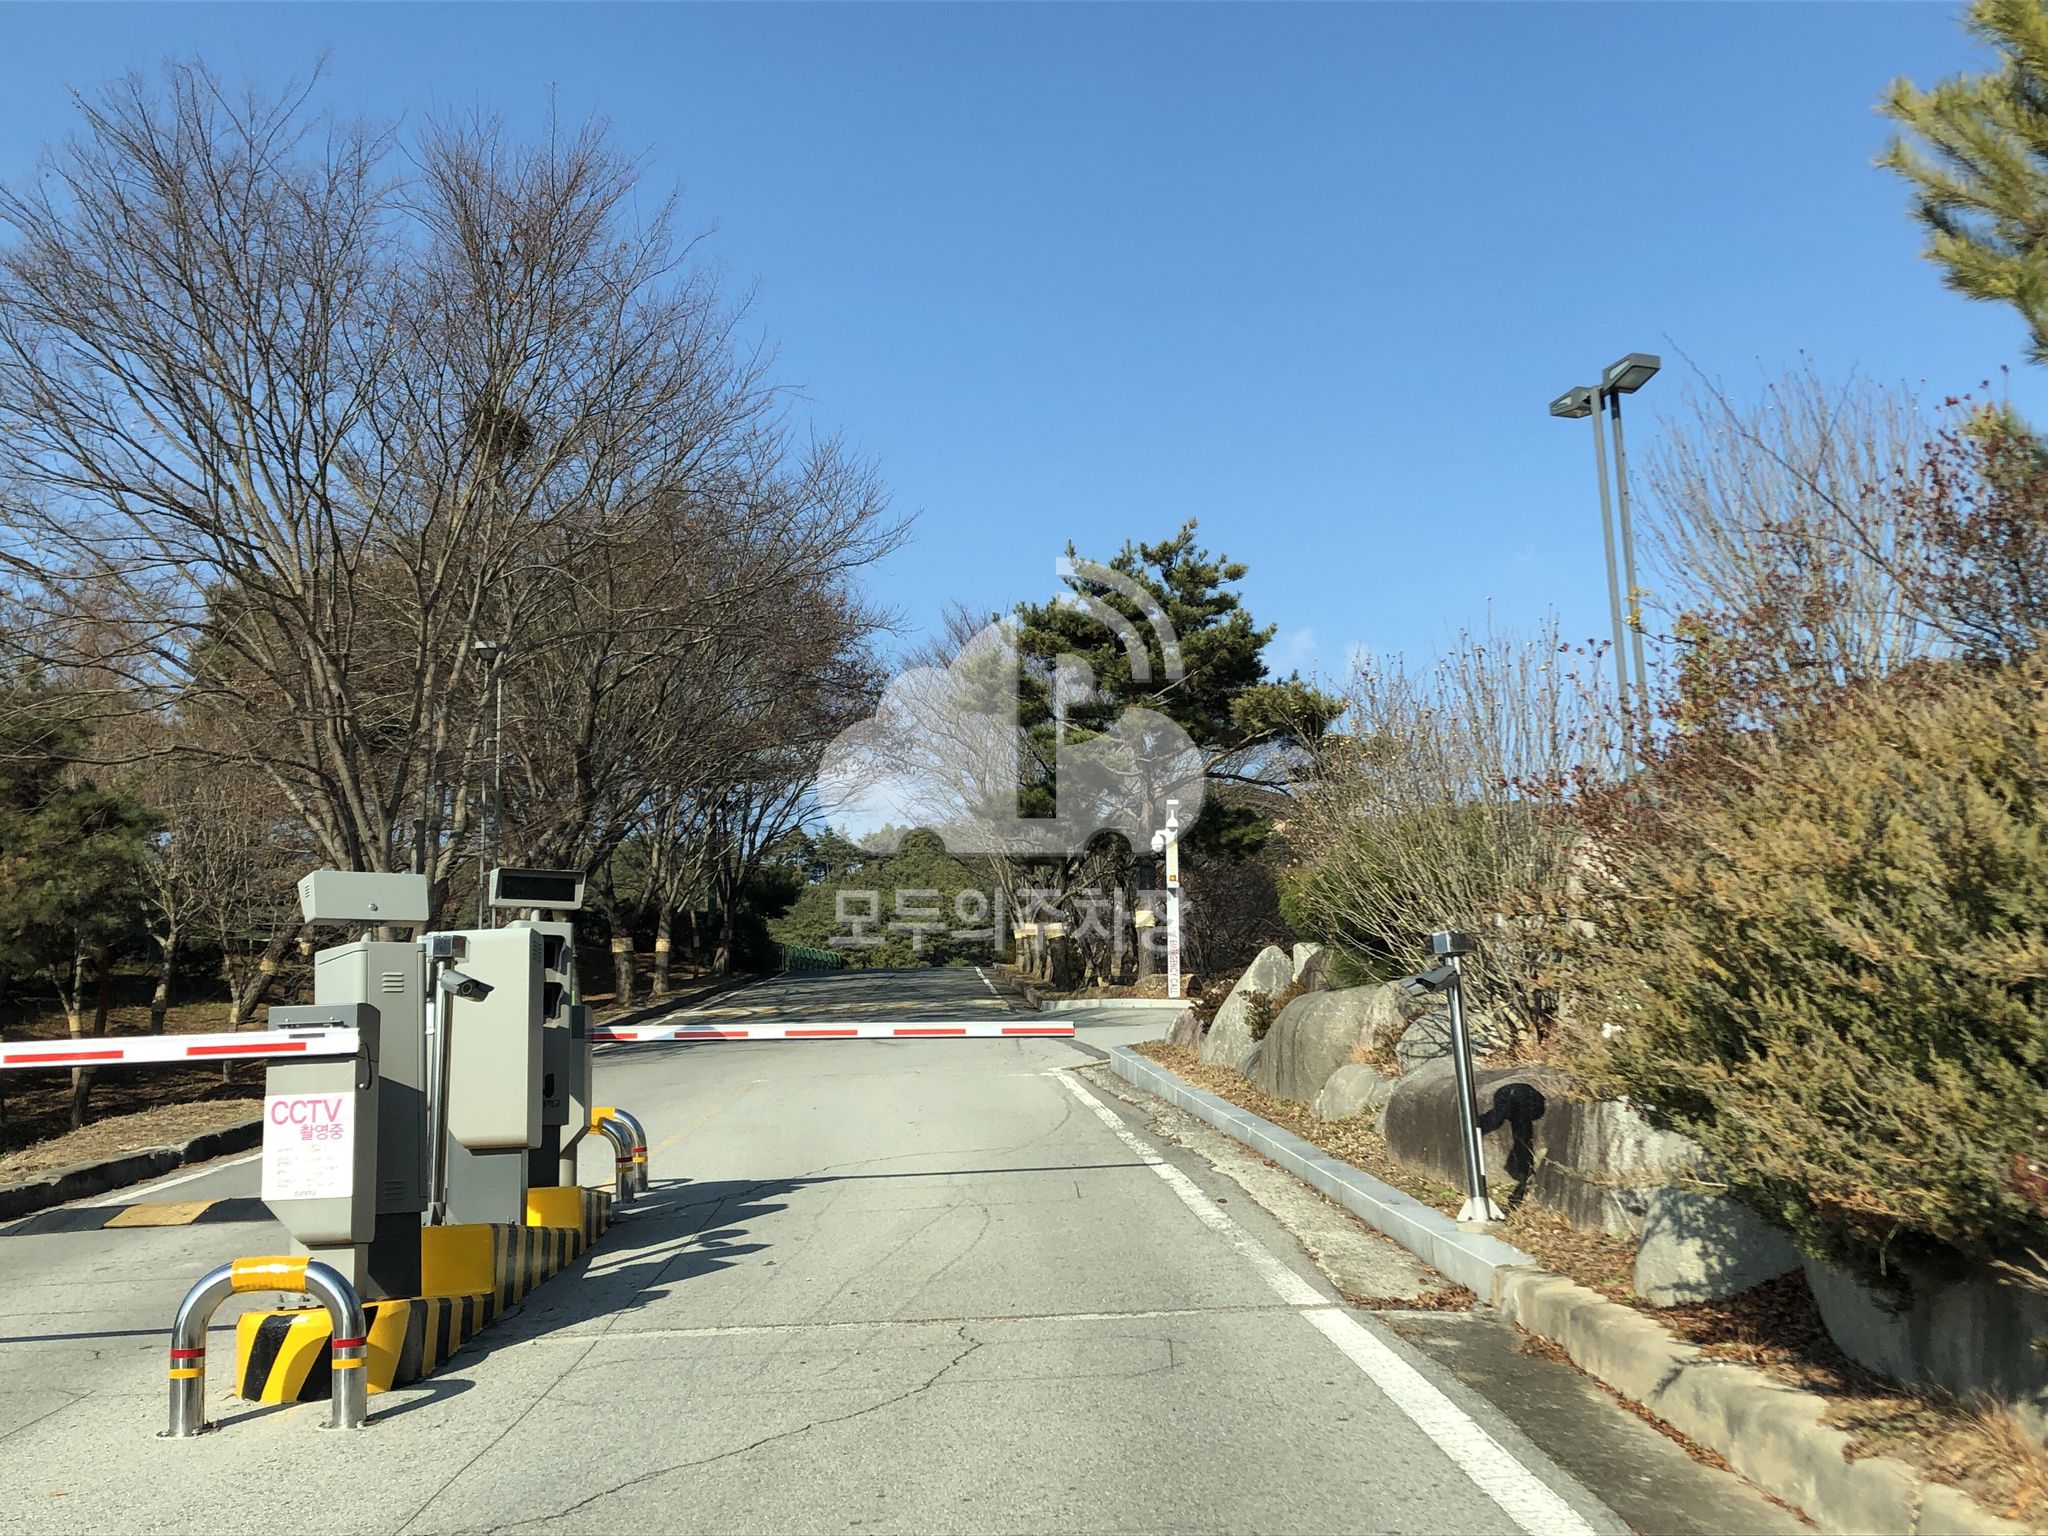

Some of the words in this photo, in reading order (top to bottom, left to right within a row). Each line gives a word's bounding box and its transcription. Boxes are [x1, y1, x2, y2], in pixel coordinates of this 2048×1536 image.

[1169, 978, 1178, 994] CALL
[270, 1098, 343, 1125] CCTV
[300, 1123, 345, 1141] 촬영중
